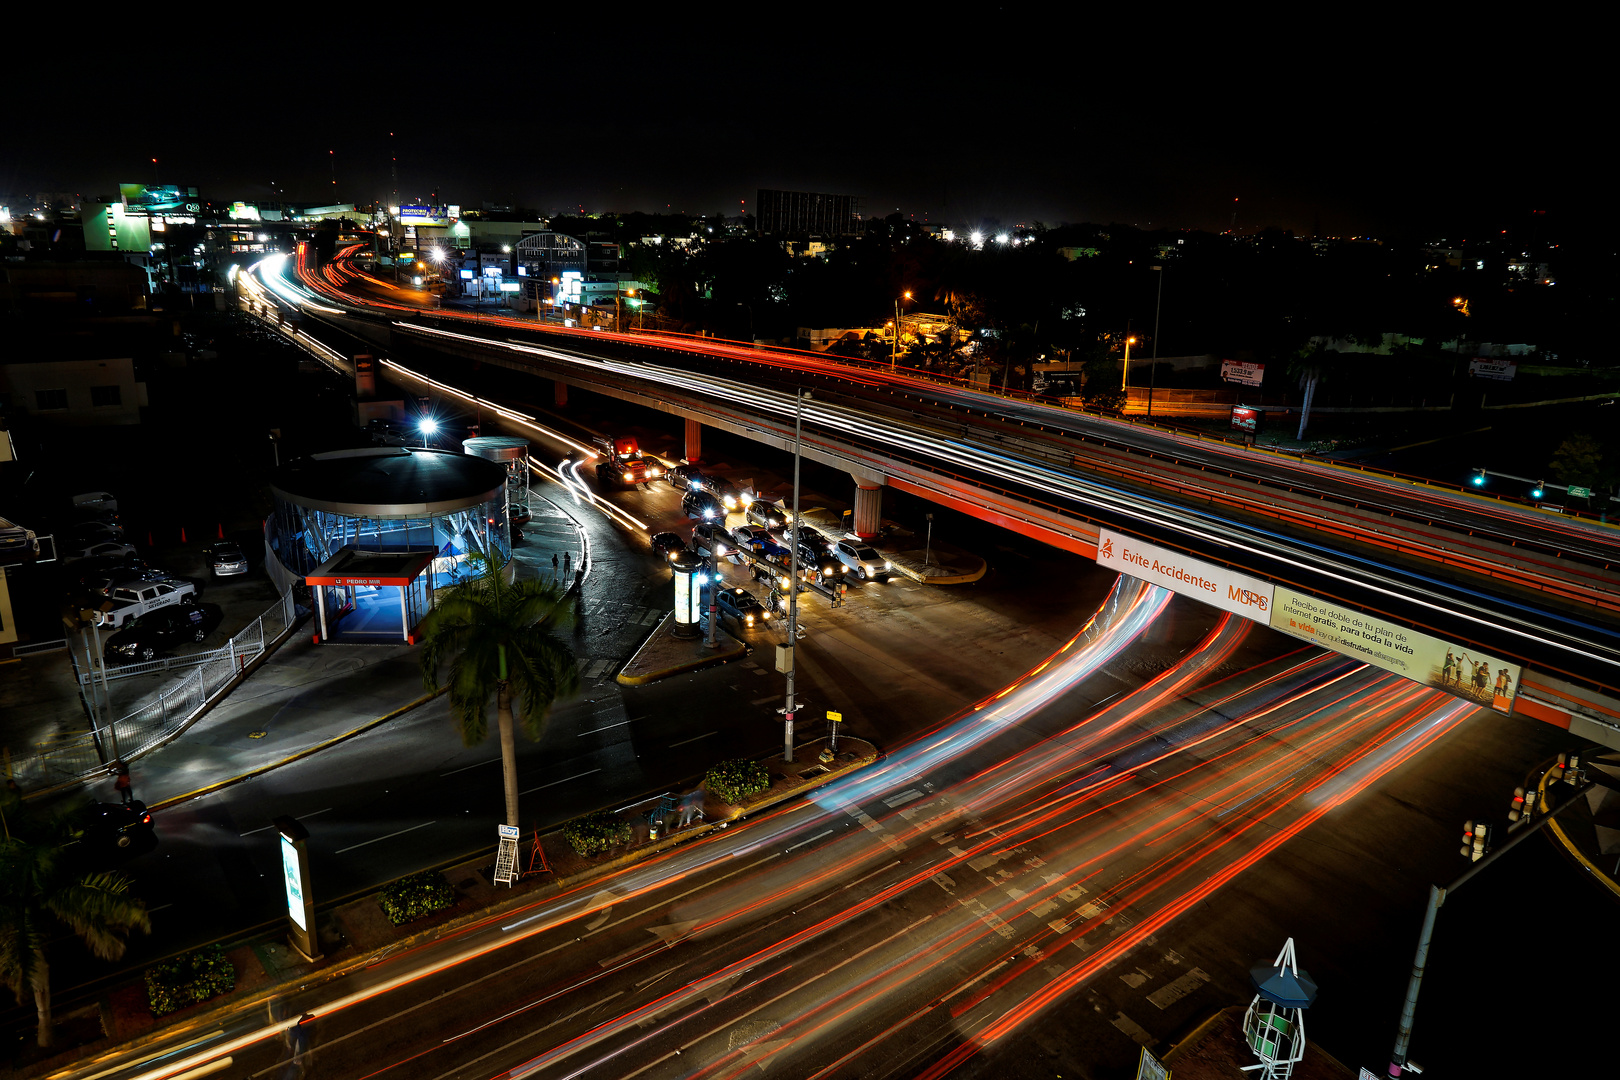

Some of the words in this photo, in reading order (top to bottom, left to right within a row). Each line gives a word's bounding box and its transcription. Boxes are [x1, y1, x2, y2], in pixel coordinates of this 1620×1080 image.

[1122, 548, 1150, 568] Evite
[1151, 560, 1218, 593] Accidentes
[1283, 603, 1312, 620] Internet
[1313, 615, 1338, 630] gratis,
[1340, 624, 1360, 637] para
[1362, 630, 1382, 644] toda
[1384, 638, 1393, 648] la
[1394, 643, 1414, 655] vida
[1289, 618, 1297, 628] la
[1298, 622, 1316, 634] vida
[1316, 629, 1328, 640] hay
[1340, 638, 1373, 656] disfrutarla
[1291, 597, 1318, 613] Recibe
[1328, 610, 1351, 624] doble
[1352, 618, 1363, 628] de
[1364, 622, 1374, 632] tu
[1375, 627, 1394, 639] plan
[1395, 633, 1407, 643] de
